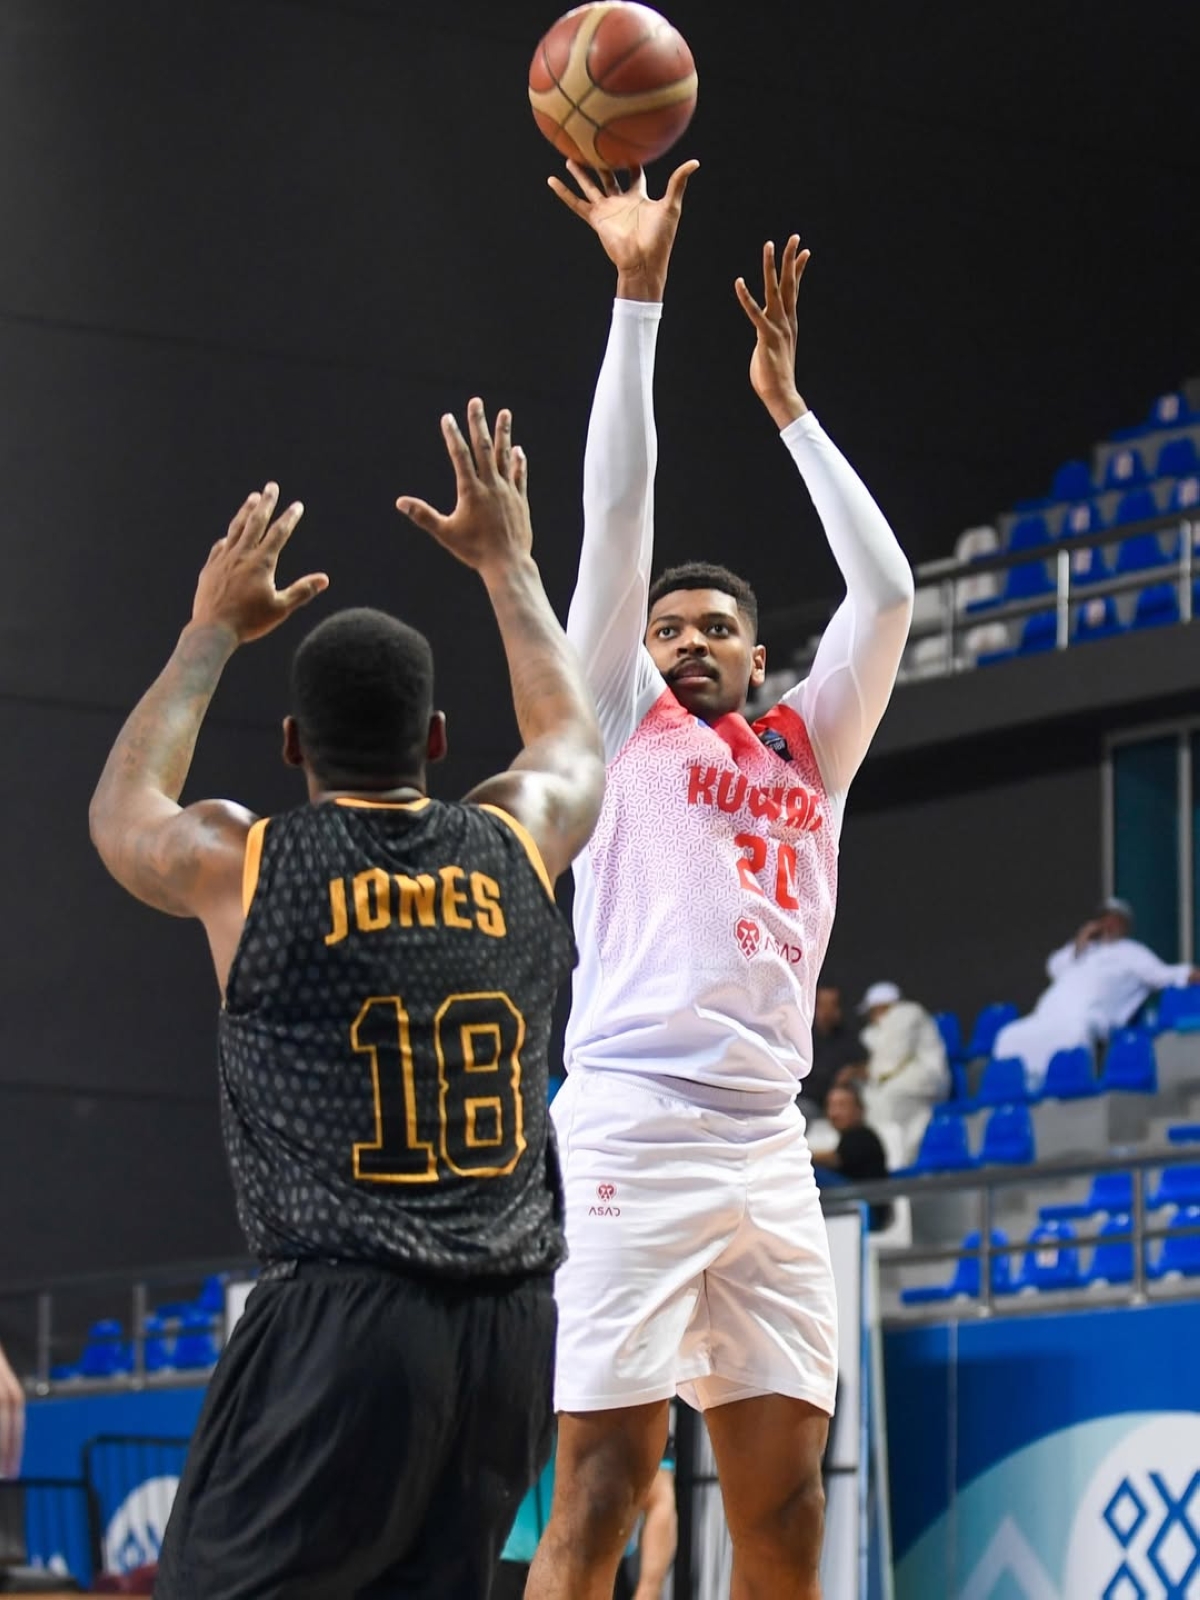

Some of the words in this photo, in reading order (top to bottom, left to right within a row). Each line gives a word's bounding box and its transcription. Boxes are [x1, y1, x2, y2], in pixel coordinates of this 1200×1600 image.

[324, 866, 506, 946] JONES
[350, 992, 526, 1182] 18
[588, 1206, 621, 1217] ASAD
